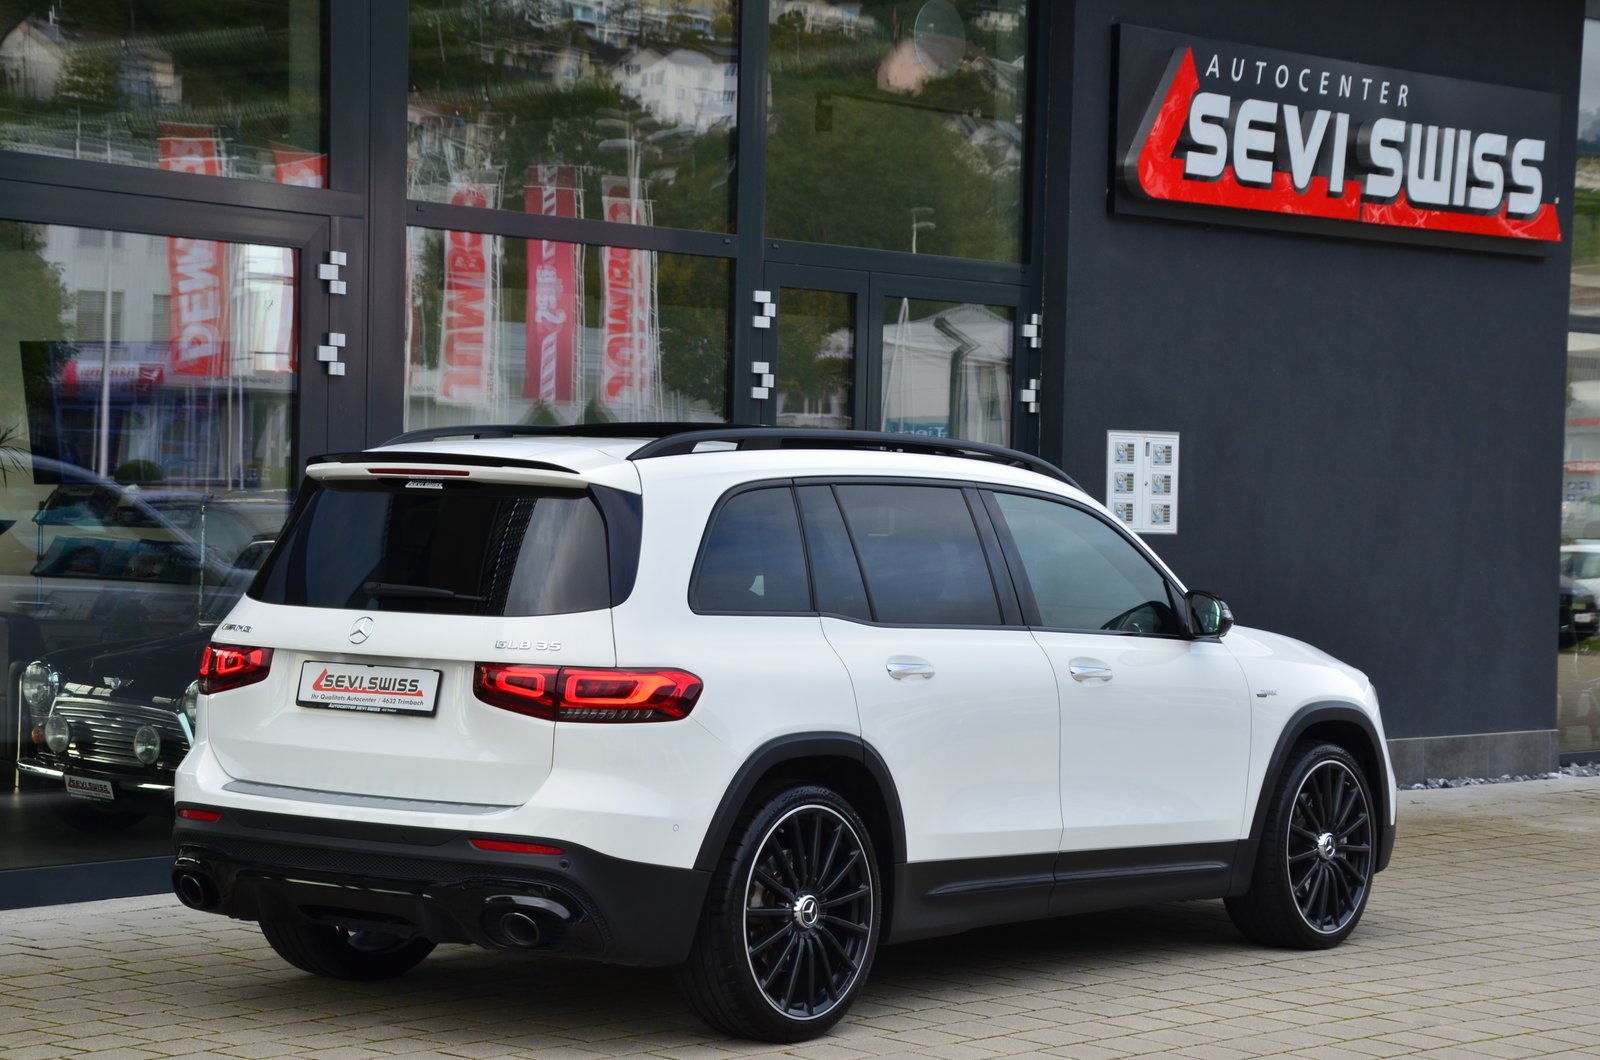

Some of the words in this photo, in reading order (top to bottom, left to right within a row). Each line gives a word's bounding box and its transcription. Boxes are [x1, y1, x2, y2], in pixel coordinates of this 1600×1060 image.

[1205, 54, 1409, 107] AUTOCENTER
[1184, 92, 1350, 194] SEVI
[1365, 118, 1546, 215] SWISS
[495, 639, 532, 650] GLB
[535, 640, 562, 651] 35
[323, 674, 364, 689] SEVI
[367, 676, 420, 693] SWISS
[346, 695, 376, 703] Autocenter
[382, 697, 397, 705] 4632
[397, 698, 424, 706] Trimbach
